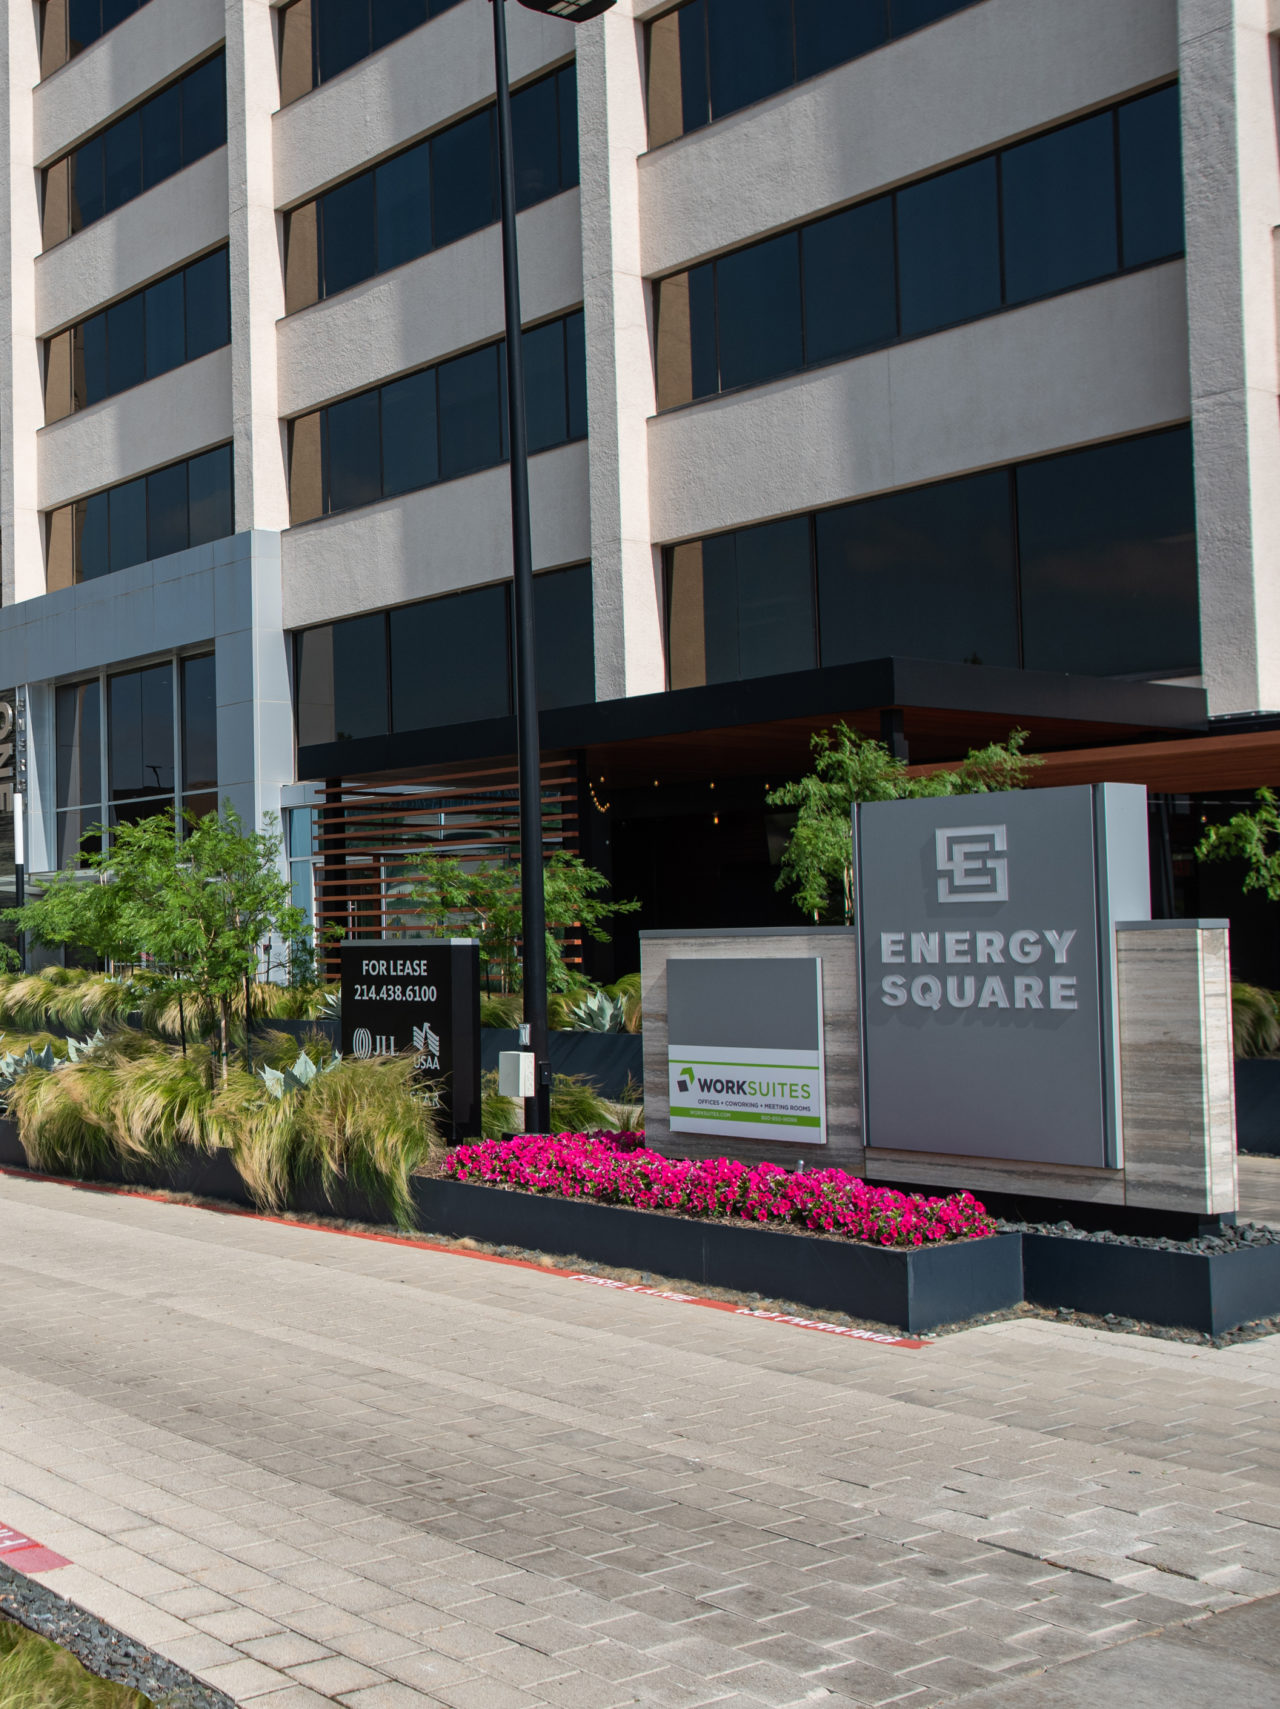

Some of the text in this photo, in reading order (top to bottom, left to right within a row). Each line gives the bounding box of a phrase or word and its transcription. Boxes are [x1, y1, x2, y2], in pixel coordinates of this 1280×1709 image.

[880, 929, 1078, 964] ENERGY
[362, 960, 428, 976] FOR LEASE
[354, 984, 437, 1002] 214.438.6100
[881, 974, 1078, 1011] SQUARE
[373, 1035, 400, 1057] JLL
[414, 1055, 440, 1070] USAA
[698, 1078, 811, 1099] WORKSUITES
[698, 1098, 720, 1106] OFFICES
[725, 1101, 759, 1109] COWORKING
[764, 1103, 789, 1111] MEETING
[568, 1274, 628, 1289] FIRE
[775, 1315, 903, 1344] PARKING
